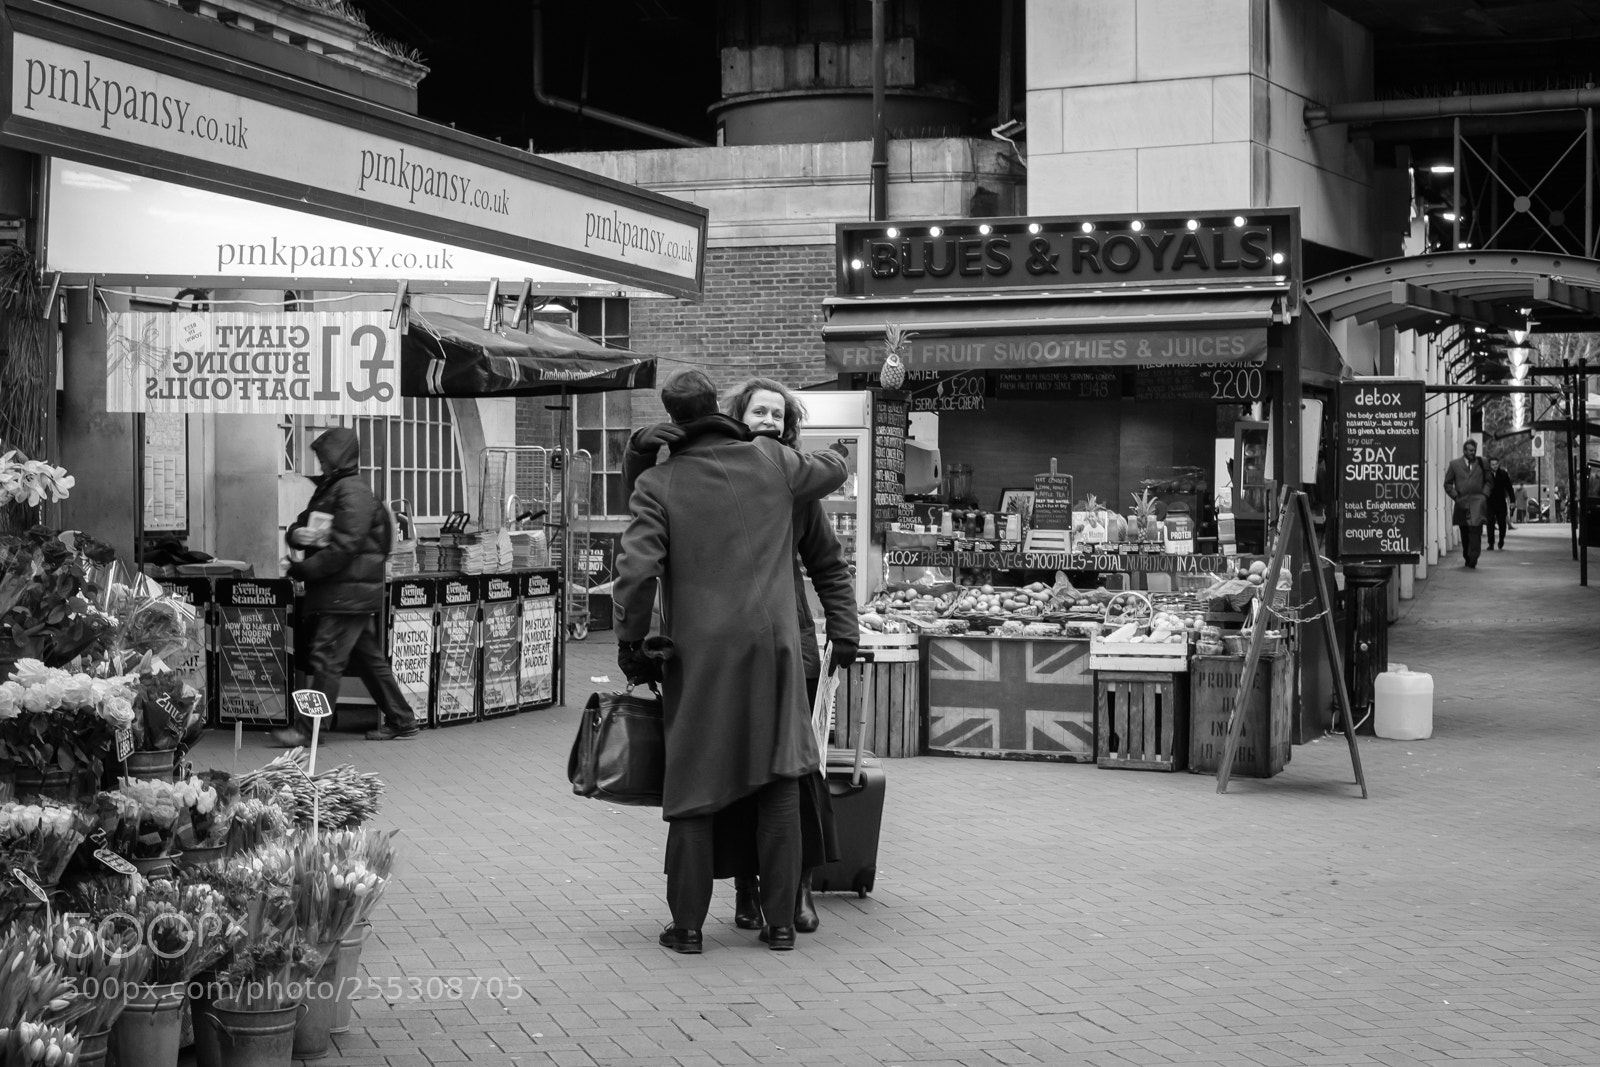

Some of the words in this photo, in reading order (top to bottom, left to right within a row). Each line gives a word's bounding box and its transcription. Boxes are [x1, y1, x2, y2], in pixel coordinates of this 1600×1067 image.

[871, 237, 1012, 279] BLUES
[1025, 236, 1060, 274] &
[1072, 230, 1268, 273] ROYALS
[842, 346, 913, 366] FREH
[923, 344, 985, 363] FRUIT
[994, 339, 1128, 362] SMOOTHIES
[1136, 338, 1152, 357] &
[1161, 336, 1246, 357] JUICES
[1079, 381, 1108, 397] 1948
[1355, 388, 1401, 405] detox
[915, 397, 938, 410] SERVE
[939, 396, 985, 410] ICE-CREAM
[1358, 412, 1373, 420] body
[1358, 428, 1375, 436] given
[1375, 427, 1385, 435] the
[1387, 427, 1411, 435] chance
[1348, 438, 1359, 446] try
[1366, 447, 1396, 462] DAY
[1346, 465, 1383, 481] SUPER
[1385, 465, 1419, 481] JUICE
[1375, 483, 1420, 499] DETOX
[1366, 500, 1416, 512] Enlightenment
[1345, 510, 1352, 518] in
[1353, 510, 1367, 518] just
[1372, 512, 1379, 523] 3
[1381, 512, 1405, 526] days
[1345, 525, 1383, 541] enquire
[1387, 526, 1401, 538] at
[889, 551, 919, 566] 100%
[920, 551, 954, 567] FRESH
[957, 552, 988, 568] FRUIT
[989, 552, 999, 568] &
[1000, 553, 1023, 569] VEG
[1126, 555, 1174, 571] NUTRITION
[1176, 556, 1188, 572] IN
[1189, 556, 1198, 574] A
[1199, 556, 1223, 573] CUP
[446, 583, 468, 593] Evening
[489, 580, 509, 590] Evening
[529, 577, 548, 587] Evening
[232, 584, 271, 596] Evening
[401, 587, 424, 597] Evening
[488, 589, 511, 600] Standard
[528, 585, 550, 596] Standard
[232, 594, 276, 604] Standard
[401, 594, 427, 606] Standard
[446, 592, 470, 603] Standard
[225, 622, 241, 630] HOW
[252, 623, 271, 631] MAKE
[525, 620, 535, 630] PM
[535, 617, 551, 629] STUCK
[242, 630, 272, 638] MODERN
[397, 632, 407, 641] PM
[407, 631, 428, 643] STUCK
[532, 630, 551, 642] MIDDLE
[395, 646, 403, 657] IN
[404, 645, 428, 656] MIDDLE
[524, 645, 532, 656] OF
[532, 643, 550, 655] BREXIT
[395, 660, 405, 670] OF
[405, 658, 427, 670] BREXIT
[524, 655, 548, 668] MUDDLE
[397, 672, 424, 684] MUDDLE
[1199, 672, 1260, 689] PRODUE
